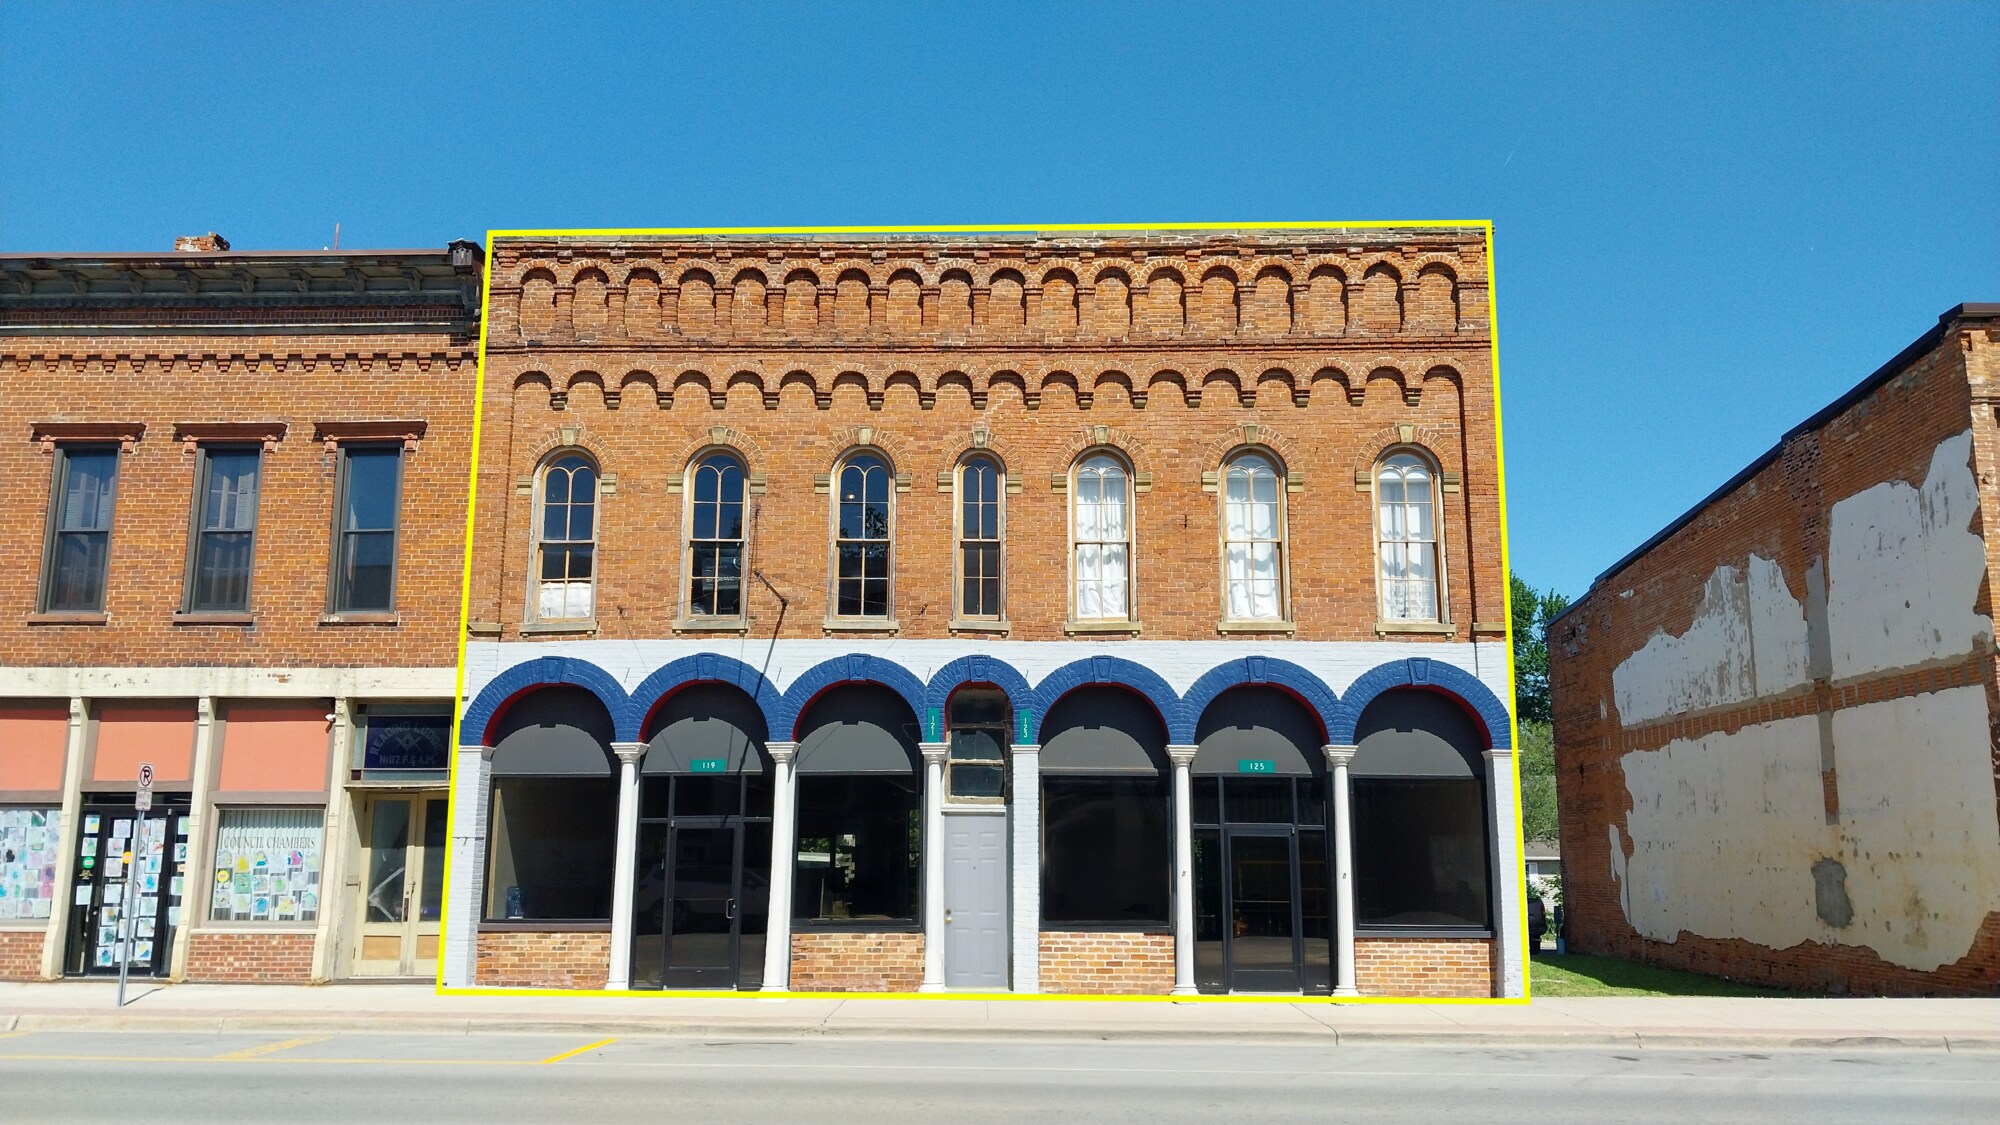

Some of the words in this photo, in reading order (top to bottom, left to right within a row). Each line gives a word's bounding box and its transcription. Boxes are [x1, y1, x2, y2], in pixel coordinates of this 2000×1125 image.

[369, 721, 411, 756] READING
[702, 761, 716, 769] 119
[1249, 762, 1265, 770] 125
[223, 836, 265, 849] COUNCIL
[266, 836, 315, 849] CHAMBERS
